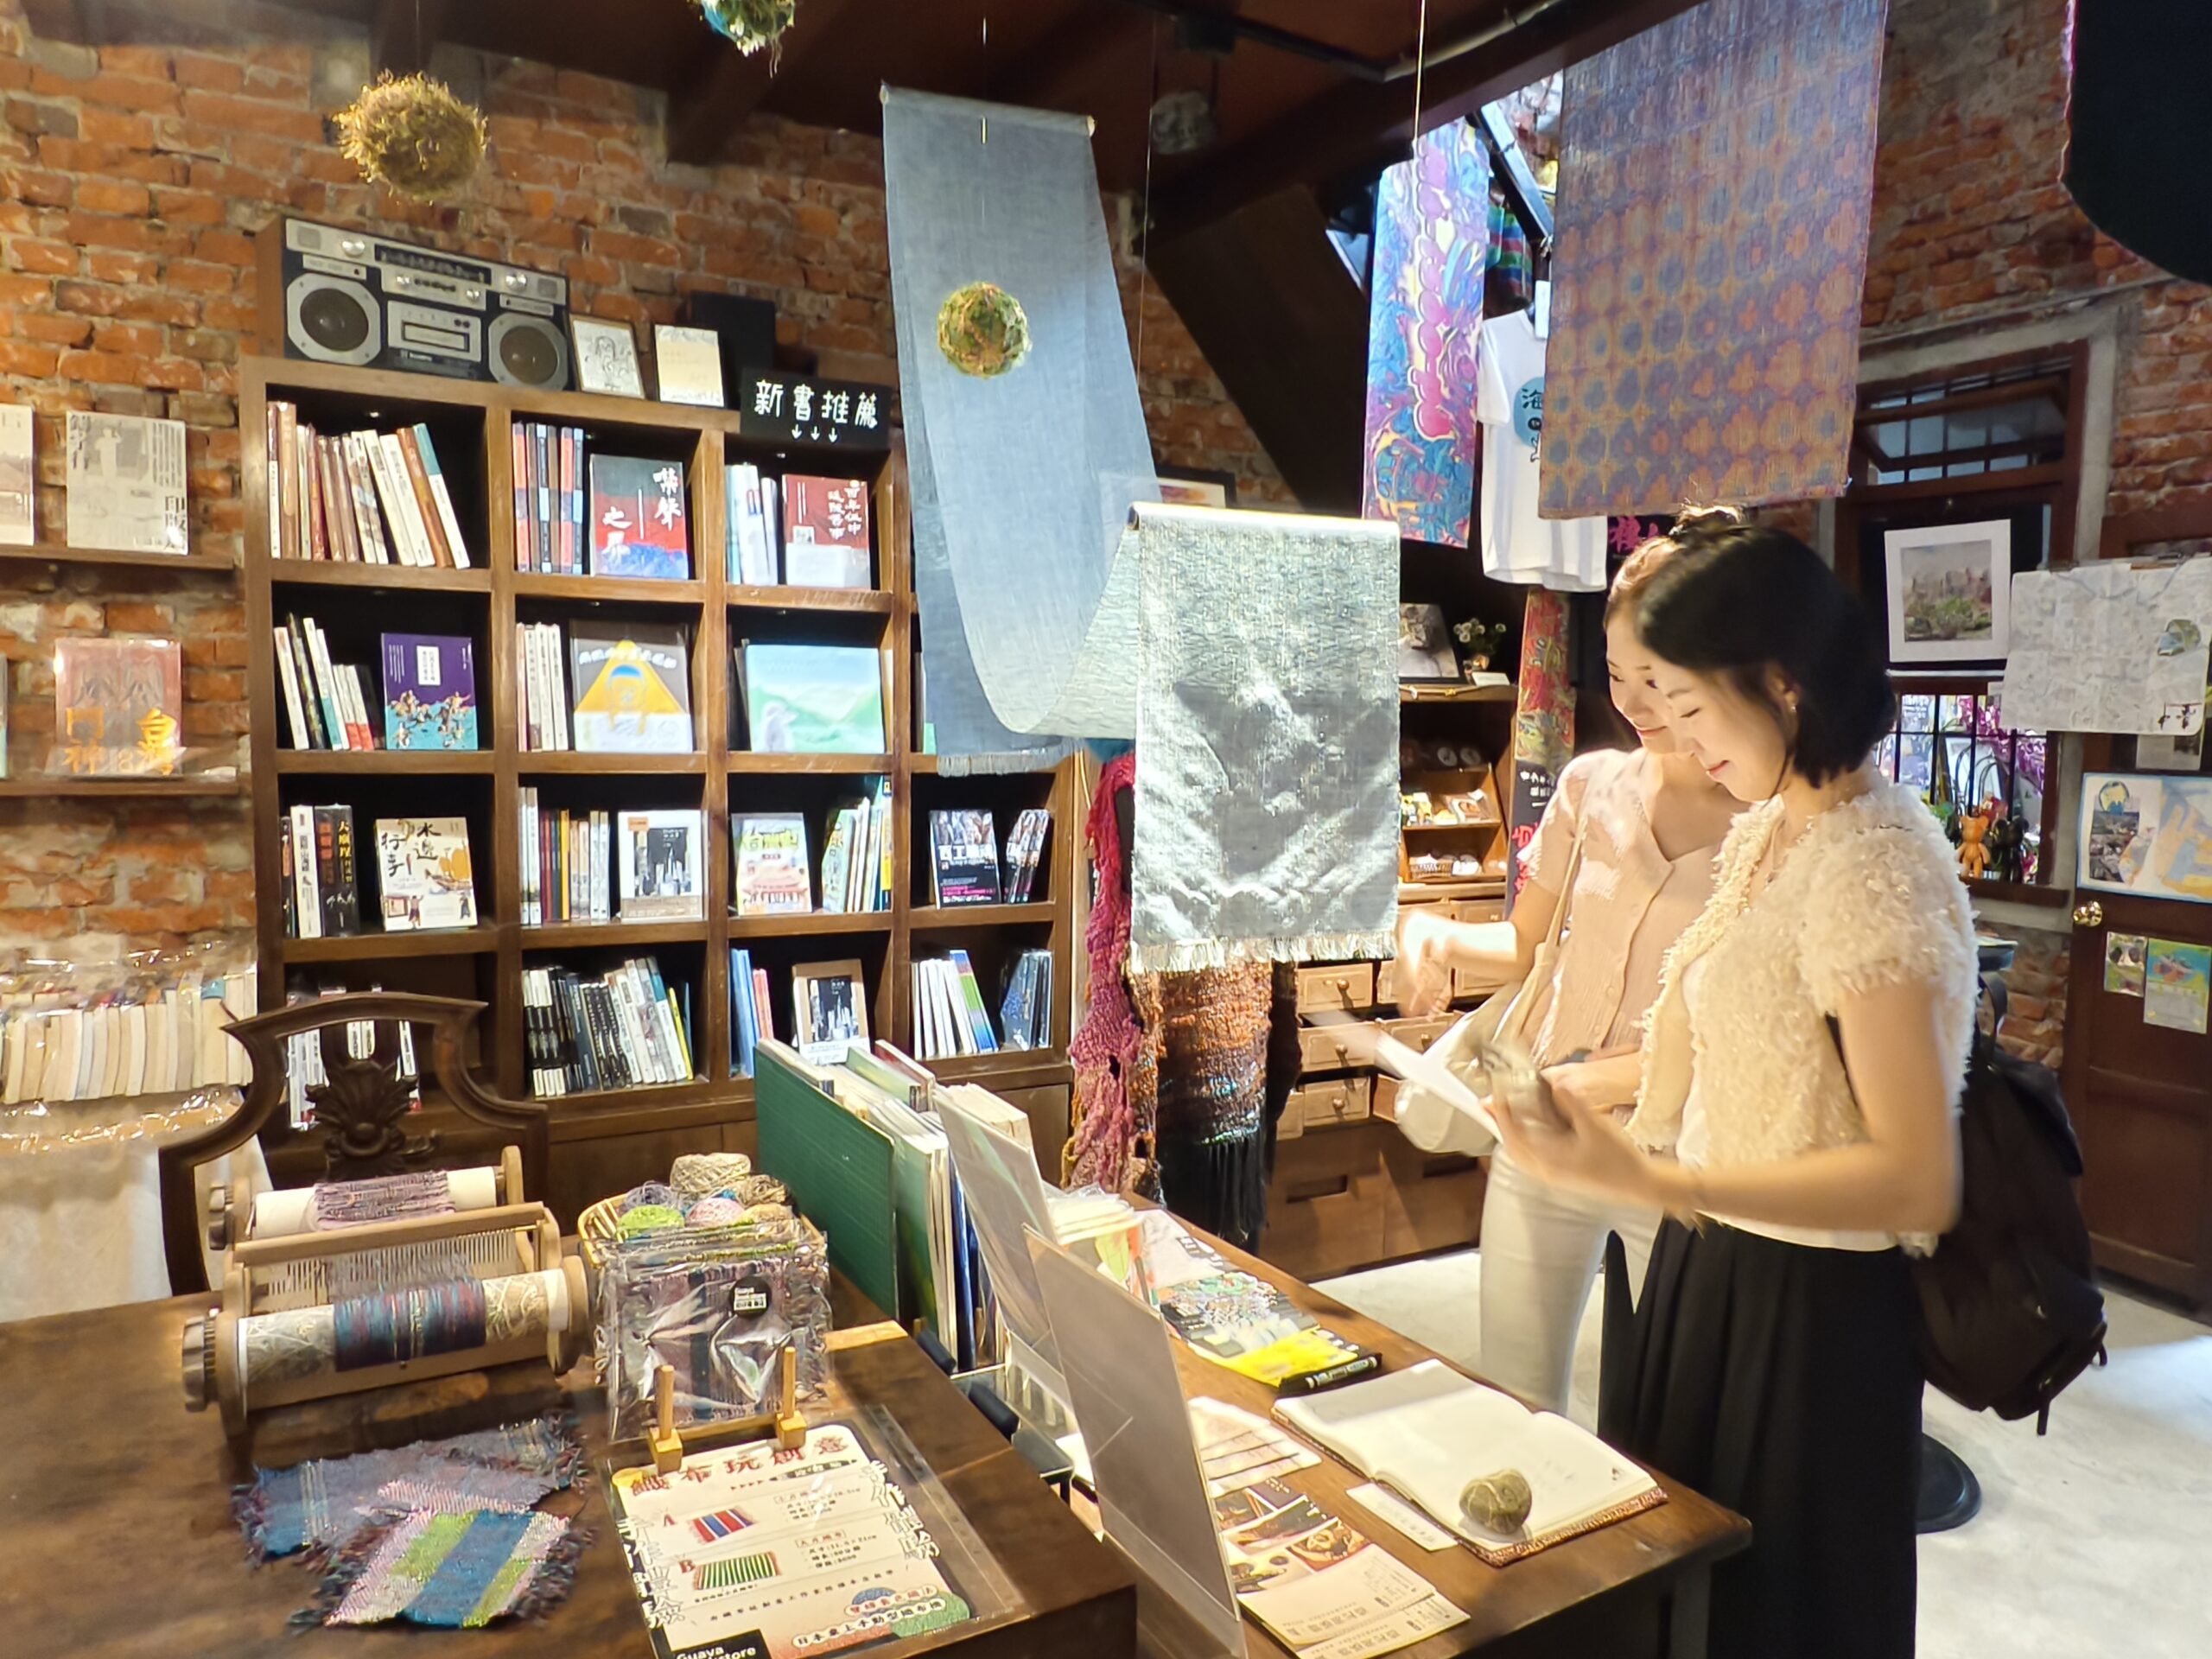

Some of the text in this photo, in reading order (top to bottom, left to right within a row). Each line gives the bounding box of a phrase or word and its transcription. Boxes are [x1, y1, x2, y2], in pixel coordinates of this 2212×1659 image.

[754, 379, 878, 429] 新書推薦
[631, 1436, 849, 1497] 織布玩創意
[664, 1514, 676, 1527] A
[679, 1560, 696, 1573] B
